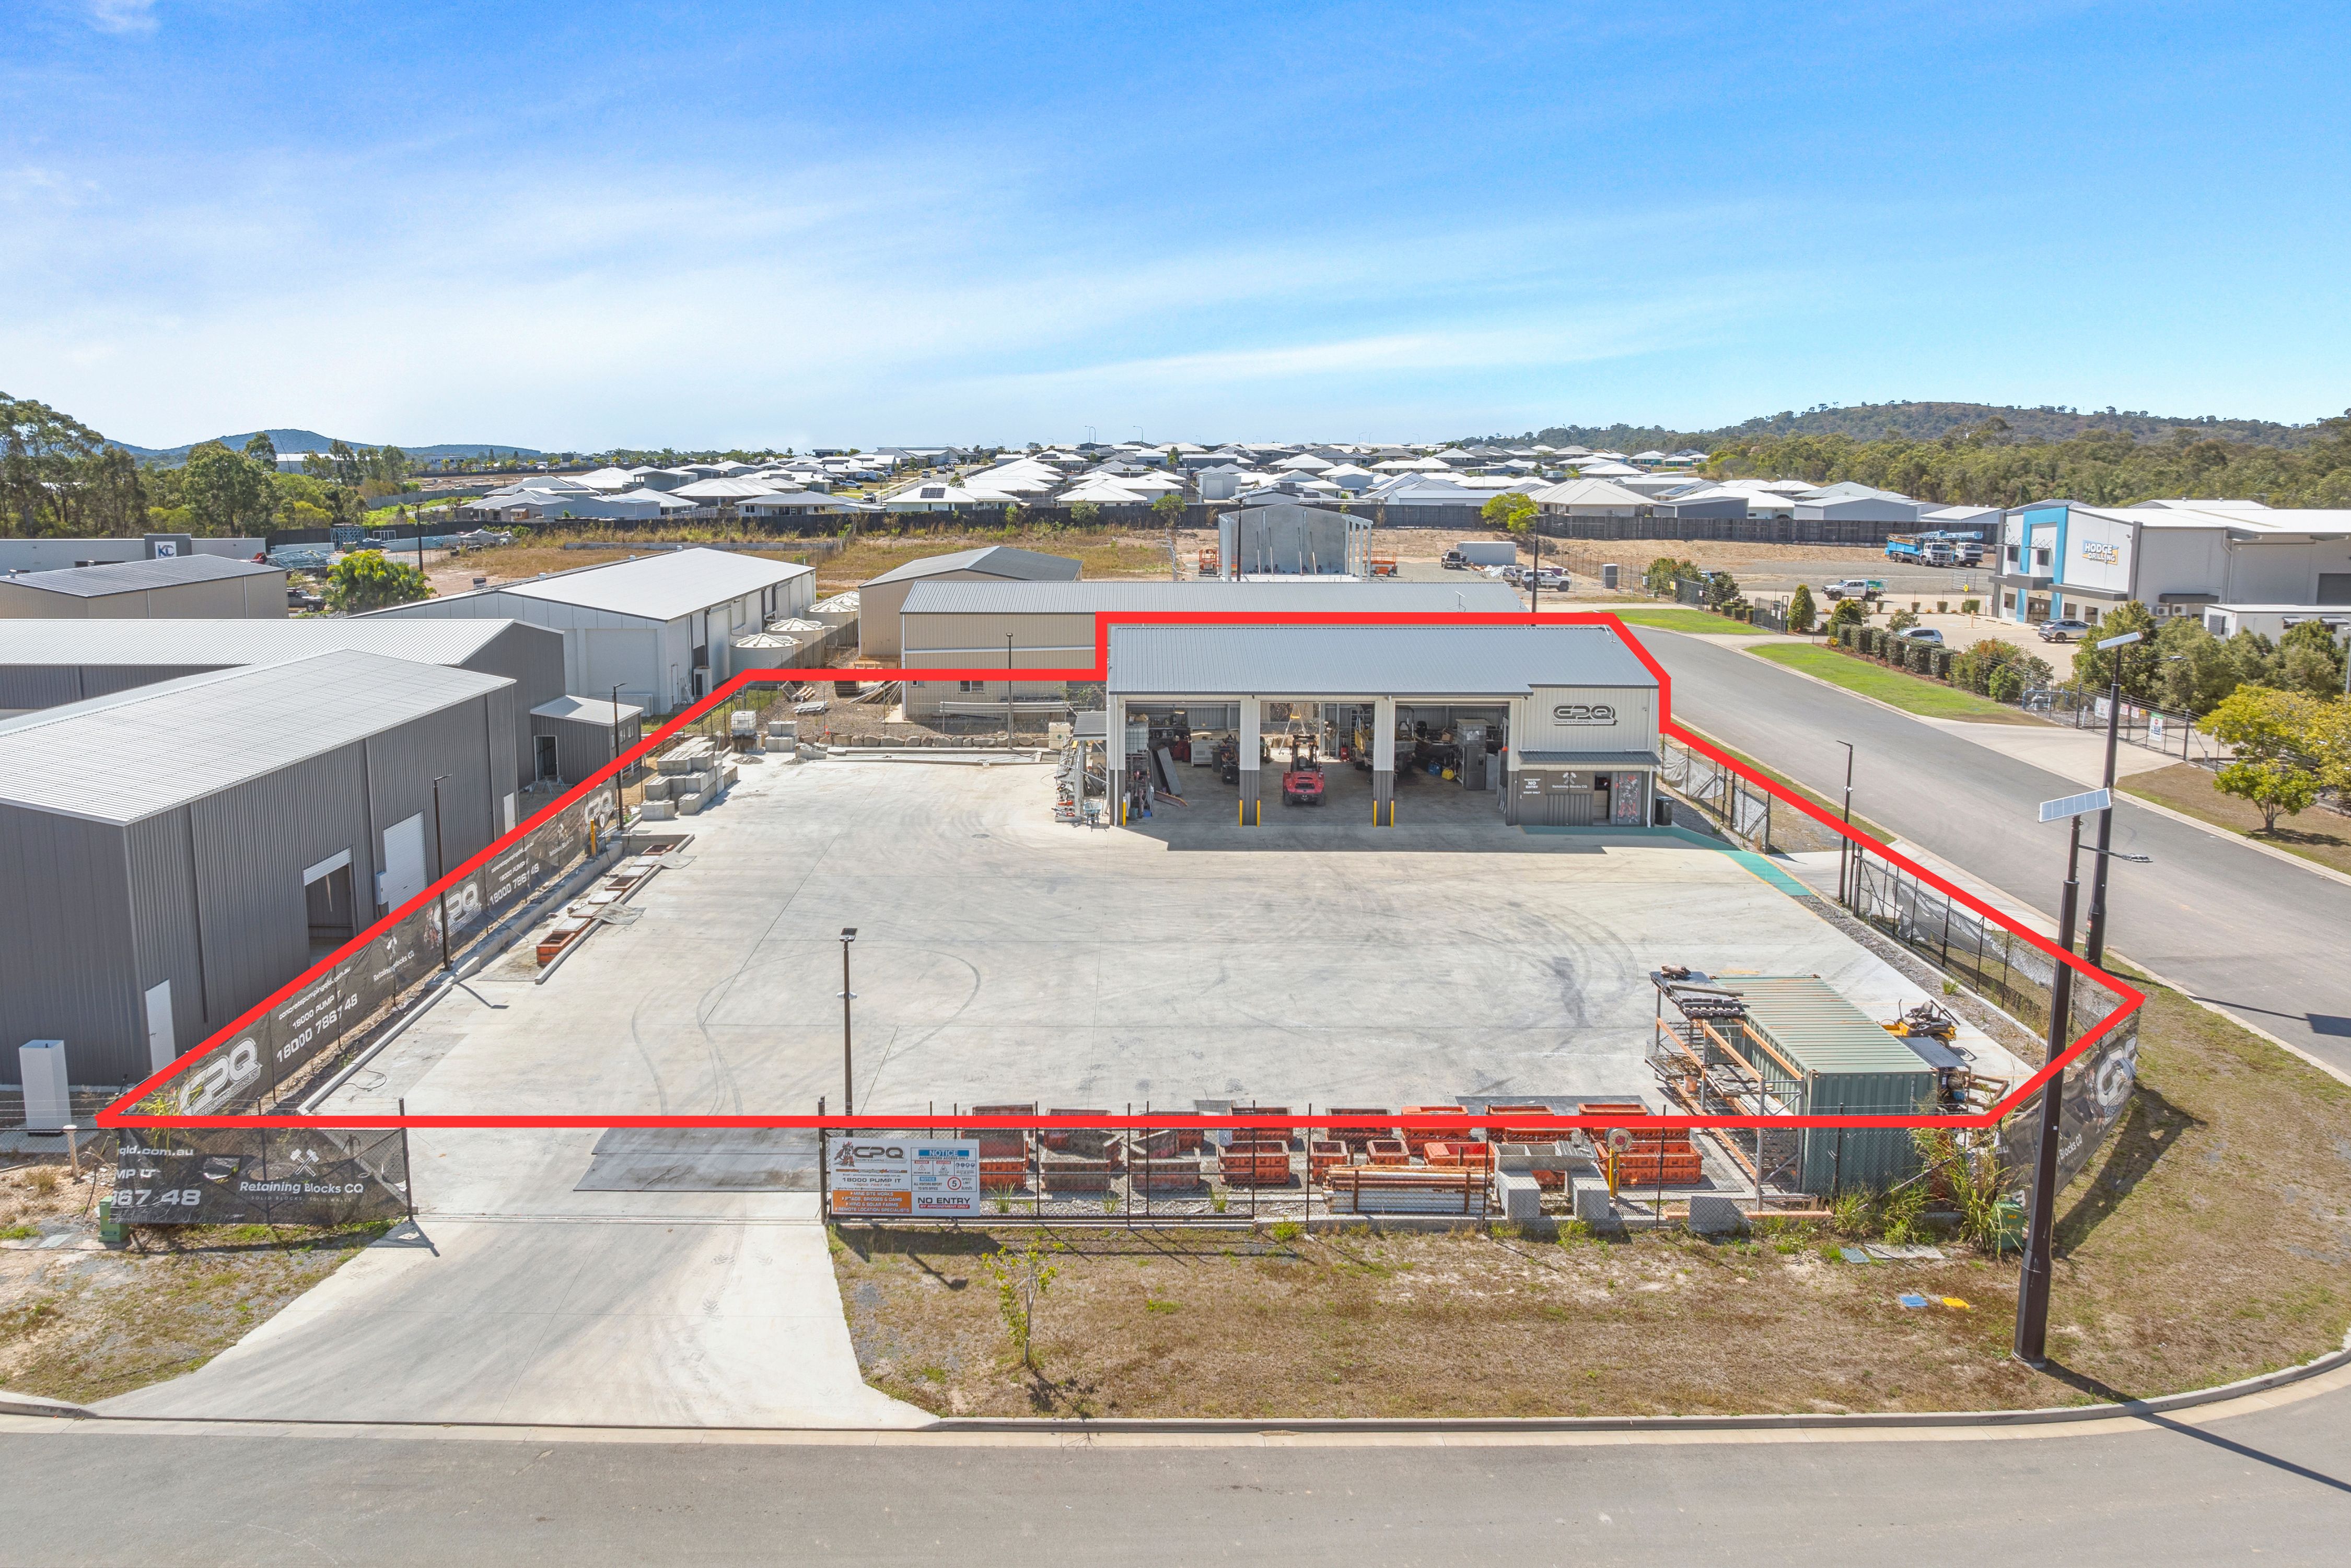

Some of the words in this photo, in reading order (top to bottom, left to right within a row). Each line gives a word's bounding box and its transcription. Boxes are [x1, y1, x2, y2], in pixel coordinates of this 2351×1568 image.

[157, 545, 174, 557] KC
[2085, 543, 2113, 554] HODGE
[2088, 553, 2116, 563] DRILLING
[1553, 704, 1615, 720] CPQ
[512, 861, 526, 873] PUMP
[490, 883, 511, 905] 18000
[531, 863, 540, 875] 48
[408, 950, 415, 959] CQ
[292, 1009, 315, 1029] 18000
[315, 994, 335, 1014] PUMP
[276, 1027, 312, 1062] 18000
[315, 1005, 343, 1035] 7867
[344, 993, 358, 1011] 48
[853, 1146, 904, 1159] CPQ
[2058, 1141, 2077, 1160] Blocks
[2075, 1133, 2082, 1146] CQ
[239, 1181, 301, 1194] Retaining
[304, 1183, 342, 1193] Blocks
[344, 1183, 364, 1193] CQ
[160, 1189, 202, 1206] 48
